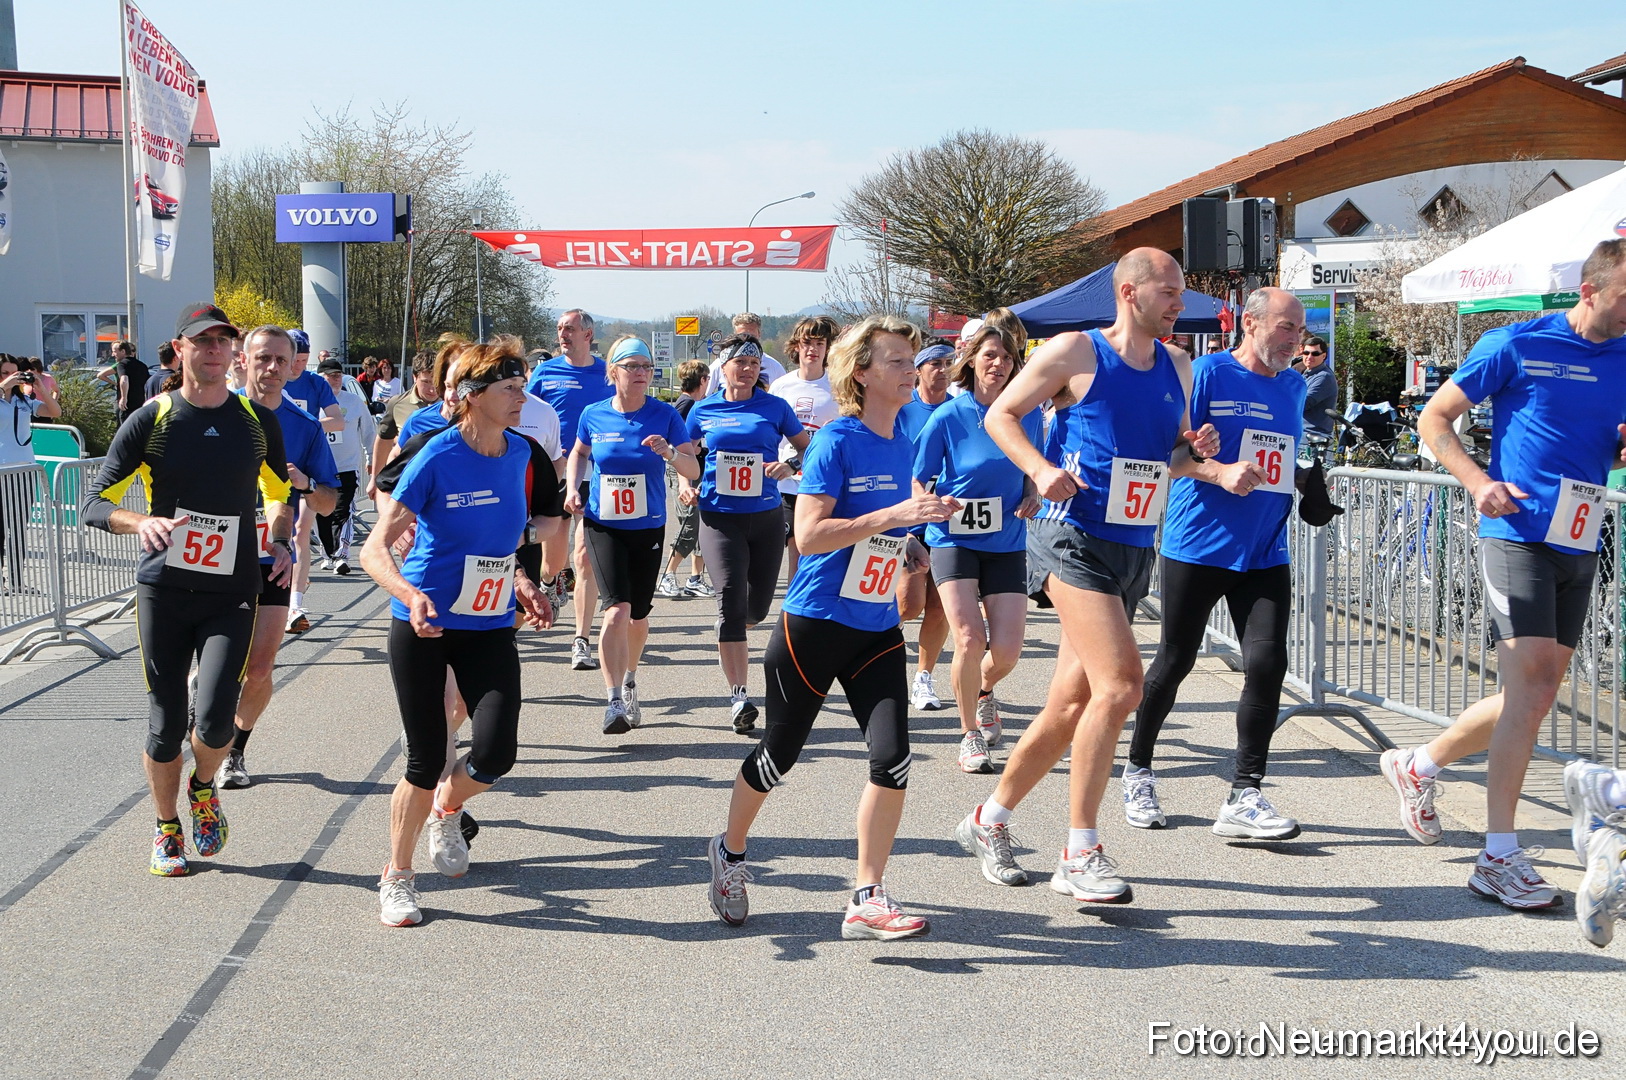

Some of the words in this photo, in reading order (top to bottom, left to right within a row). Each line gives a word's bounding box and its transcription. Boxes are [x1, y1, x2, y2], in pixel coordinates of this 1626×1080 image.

[137, 33, 172, 66] LEBEN
[155, 64, 198, 99] VOLVO.
[147, 144, 170, 163] VOLVO
[287, 207, 378, 226] VOLVO
[1459, 268, 1513, 292] Weißbier
[796, 413, 818, 421] EAT
[325, 432, 337, 443] 5
[1251, 441, 1278, 450] WERBUNG
[1252, 433, 1278, 444] MEYER
[1123, 470, 1153, 479] WERBUNG
[1124, 462, 1153, 473] MEYER
[1255, 449, 1282, 485] 16
[728, 466, 752, 491] 18
[1570, 491, 1594, 501] WERBUNG
[1571, 483, 1596, 496] MEYER
[612, 488, 635, 515] 19
[1124, 481, 1157, 519] 57
[961, 501, 992, 530] 45
[1570, 503, 1590, 540] 6
[183, 530, 224, 568] 52
[868, 544, 896, 556] WERBUNG
[870, 535, 898, 549] MEYER
[477, 559, 504, 568] MEYER
[859, 555, 898, 596] 58
[472, 577, 504, 612] 61
